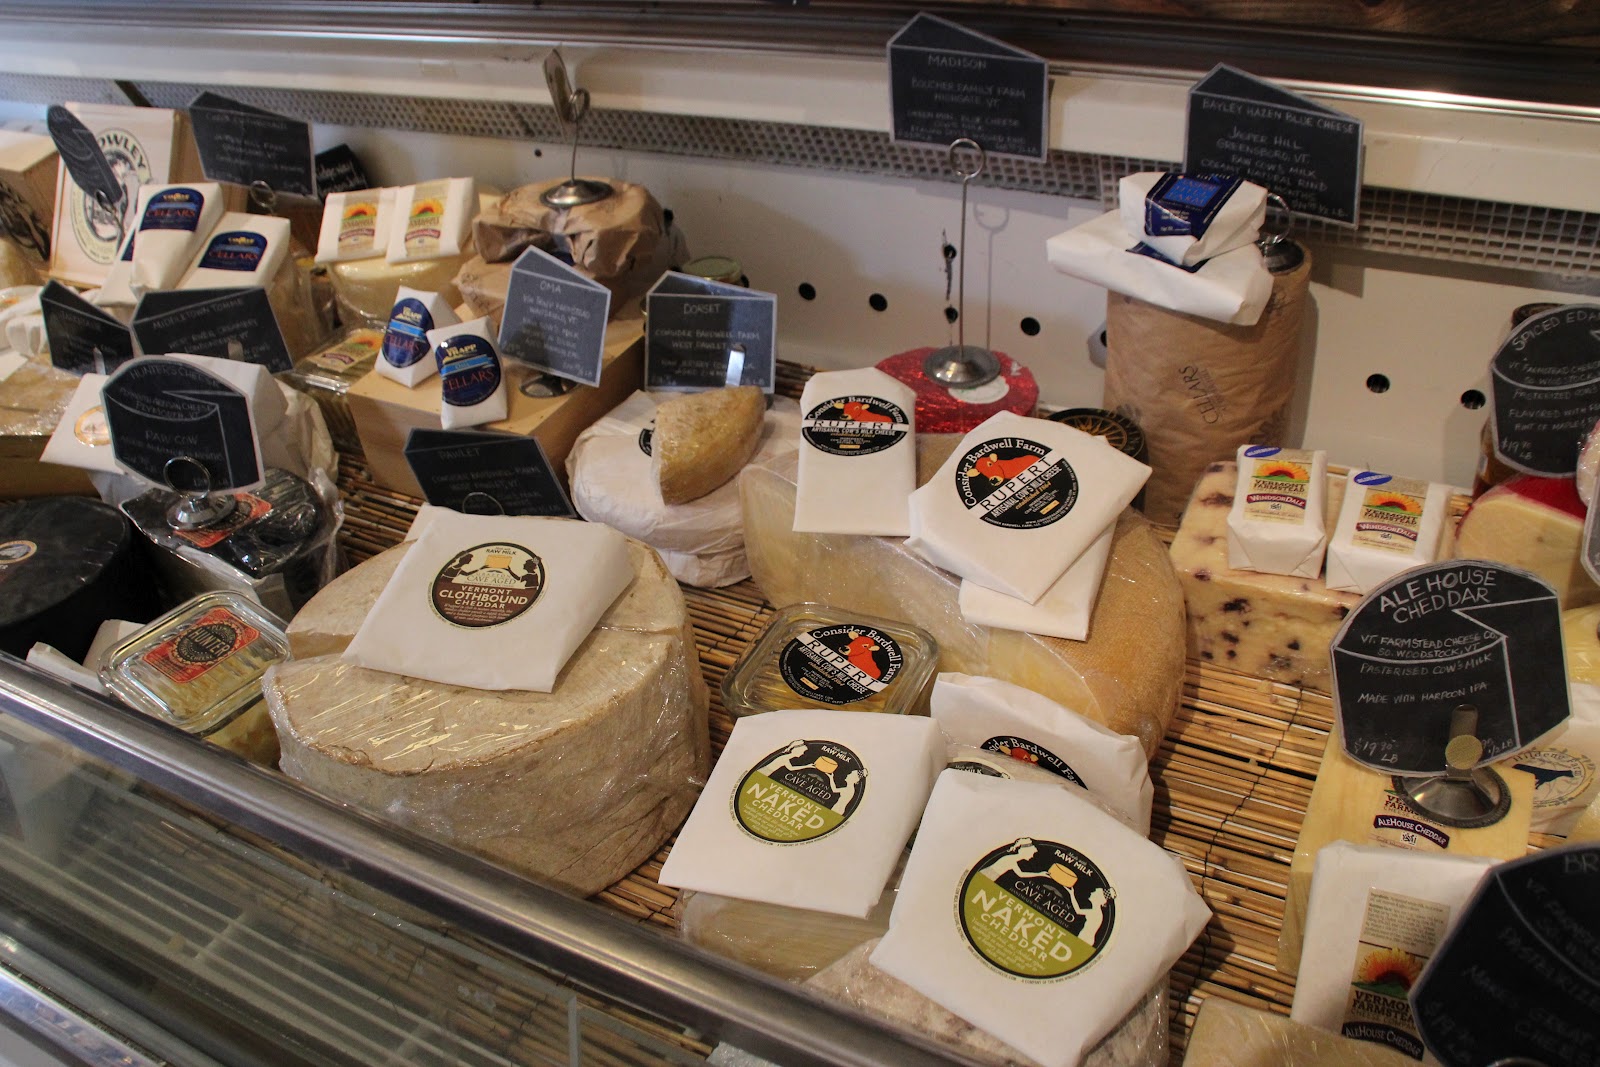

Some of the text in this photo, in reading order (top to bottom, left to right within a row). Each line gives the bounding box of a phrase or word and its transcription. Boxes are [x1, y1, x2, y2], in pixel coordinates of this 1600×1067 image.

[927, 54, 987, 70] MADISON
[957, 82, 994, 96] FAMILY
[996, 86, 1026, 99] FARM
[1202, 101, 1356, 134] BAYLEY HAZEN BLUE CHEESE
[100, 131, 147, 168] OWLEY
[1273, 135, 1304, 150] HILL
[1288, 166, 1317, 179] MILK
[1297, 177, 1329, 192] RIND
[540, 280, 562, 294] OMA
[684, 303, 720, 315] DORSET
[672, 341, 694, 350] WEST
[738, 331, 761, 341] FARM
[1512, 316, 1560, 351] SPICED
[1179, 365, 1219, 425] CELLARS
[807, 396, 904, 423] Consider Bardwell Farm
[1508, 408, 1562, 419] FLAVORED
[811, 426, 840, 434] ARTISANAL
[874, 429, 896, 437] CHEESE
[813, 420, 894, 431] RUPERT
[437, 447, 481, 462] PAWLET
[957, 438, 1046, 506] Consider Bardwell Farm
[979, 456, 1052, 512] RUPERT
[990, 495, 1020, 518] ARTISANAL
[1015, 485, 1036, 503] COW'S
[1031, 477, 1048, 491] MILK
[1041, 464, 1063, 482] CHEESE
[461, 585, 513, 596] VERMONT
[466, 574, 518, 585] CAVE AGED
[438, 589, 529, 605] CLOTHBOUND
[454, 599, 506, 609] CHEDDAR
[1393, 587, 1490, 624] CHEDDAR
[187, 626, 231, 658] HUNTER
[813, 626, 902, 682] Consider Bardwell Farm
[1379, 636, 1443, 650] FARMSTEAD
[1443, 634, 1481, 648] CHEESE
[798, 645, 825, 665] ARTISANAL
[835, 669, 851, 682] MILK
[846, 679, 868, 695] CHEESE
[806, 639, 880, 688] RUPERT
[1359, 662, 1429, 677] PASTERISED
[1464, 652, 1494, 671] MILK
[1357, 681, 1490, 705] MADE WITH HARPOON IPA
[821, 745, 852, 763] RAW MILK
[987, 738, 1009, 752] sider
[1009, 737, 1063, 768] Bardwell
[1381, 752, 1399, 764] LB
[769, 782, 822, 814] VERMONT
[784, 772, 808, 788] CAVE
[805, 785, 832, 801] AGED
[746, 783, 825, 829] NAKED
[751, 799, 804, 830] CHEDDAR
[1054, 849, 1094, 877] RAW MILK
[1014, 880, 1075, 923] CAVE AGED
[972, 889, 1073, 962] NAKED
[999, 891, 1066, 940] VERMONT
[980, 913, 1048, 962] CHEDDAR
[1353, 999, 1414, 1021] FARMSTEA
